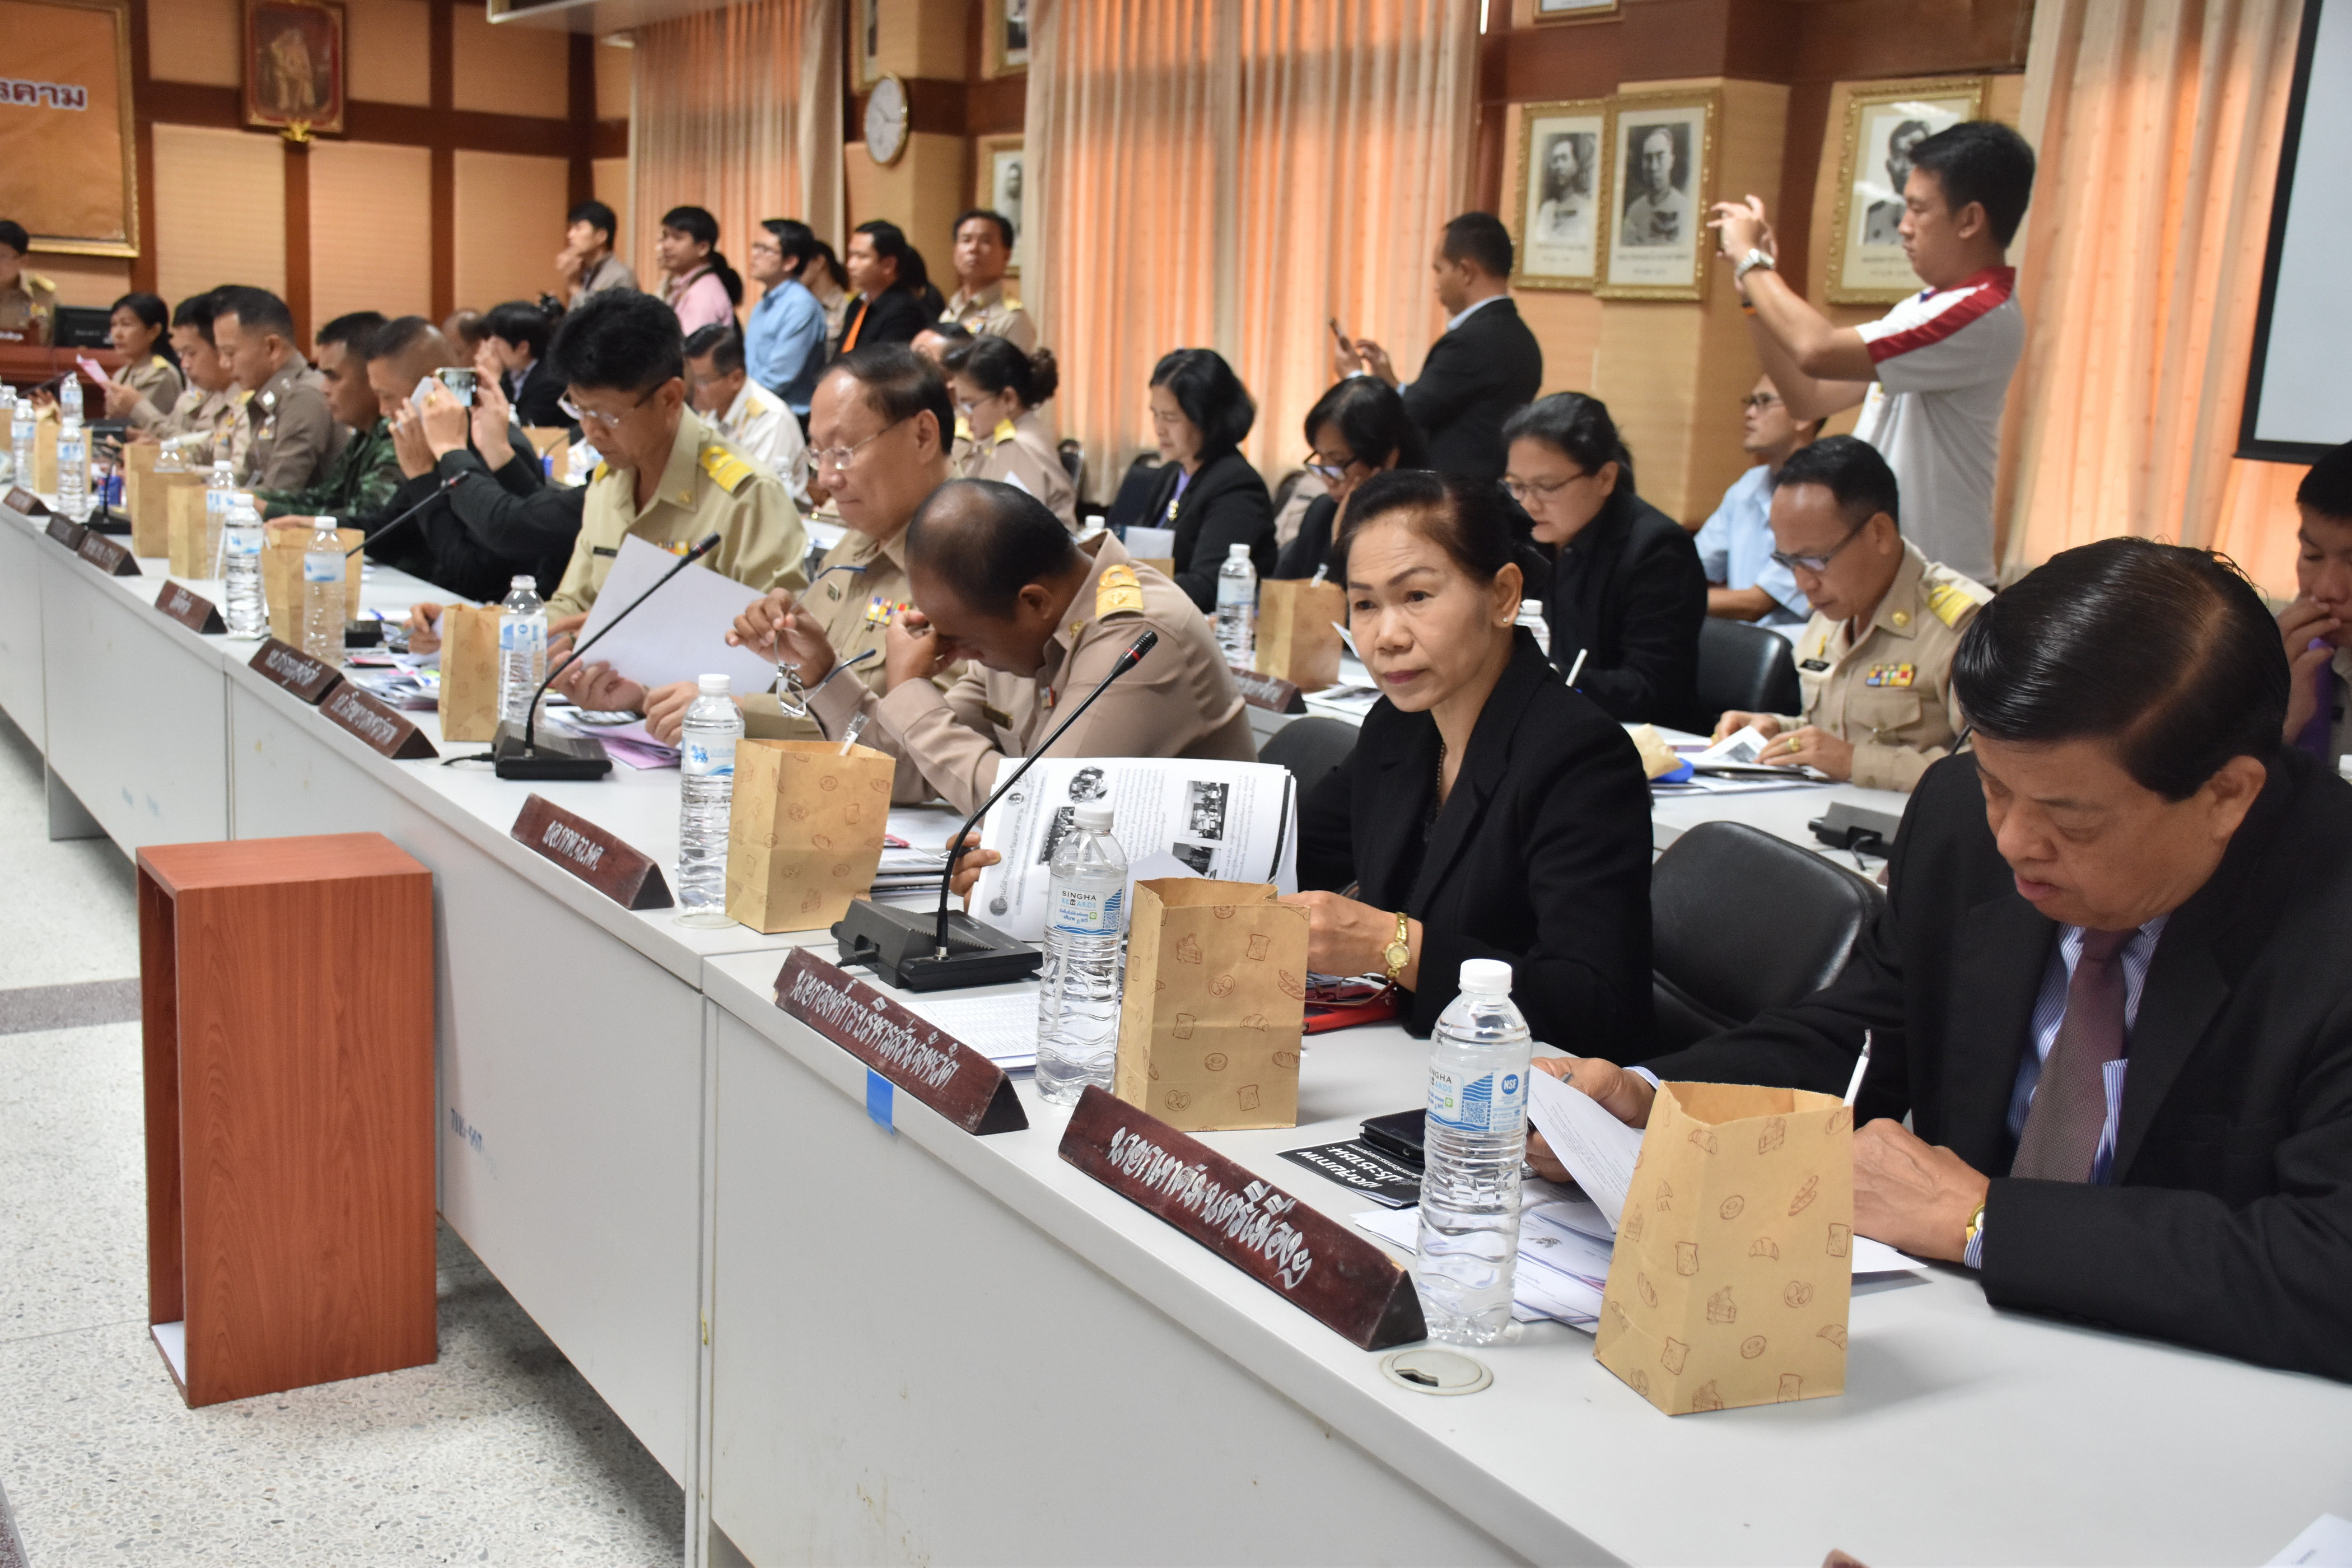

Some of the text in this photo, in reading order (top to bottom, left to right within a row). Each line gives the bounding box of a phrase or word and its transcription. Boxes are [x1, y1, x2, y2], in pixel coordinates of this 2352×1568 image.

[1062, 890, 1096, 900] SINGHA
[1429, 1065, 1452, 1084] INGHA
[1504, 1079, 1517, 1090] NSF
